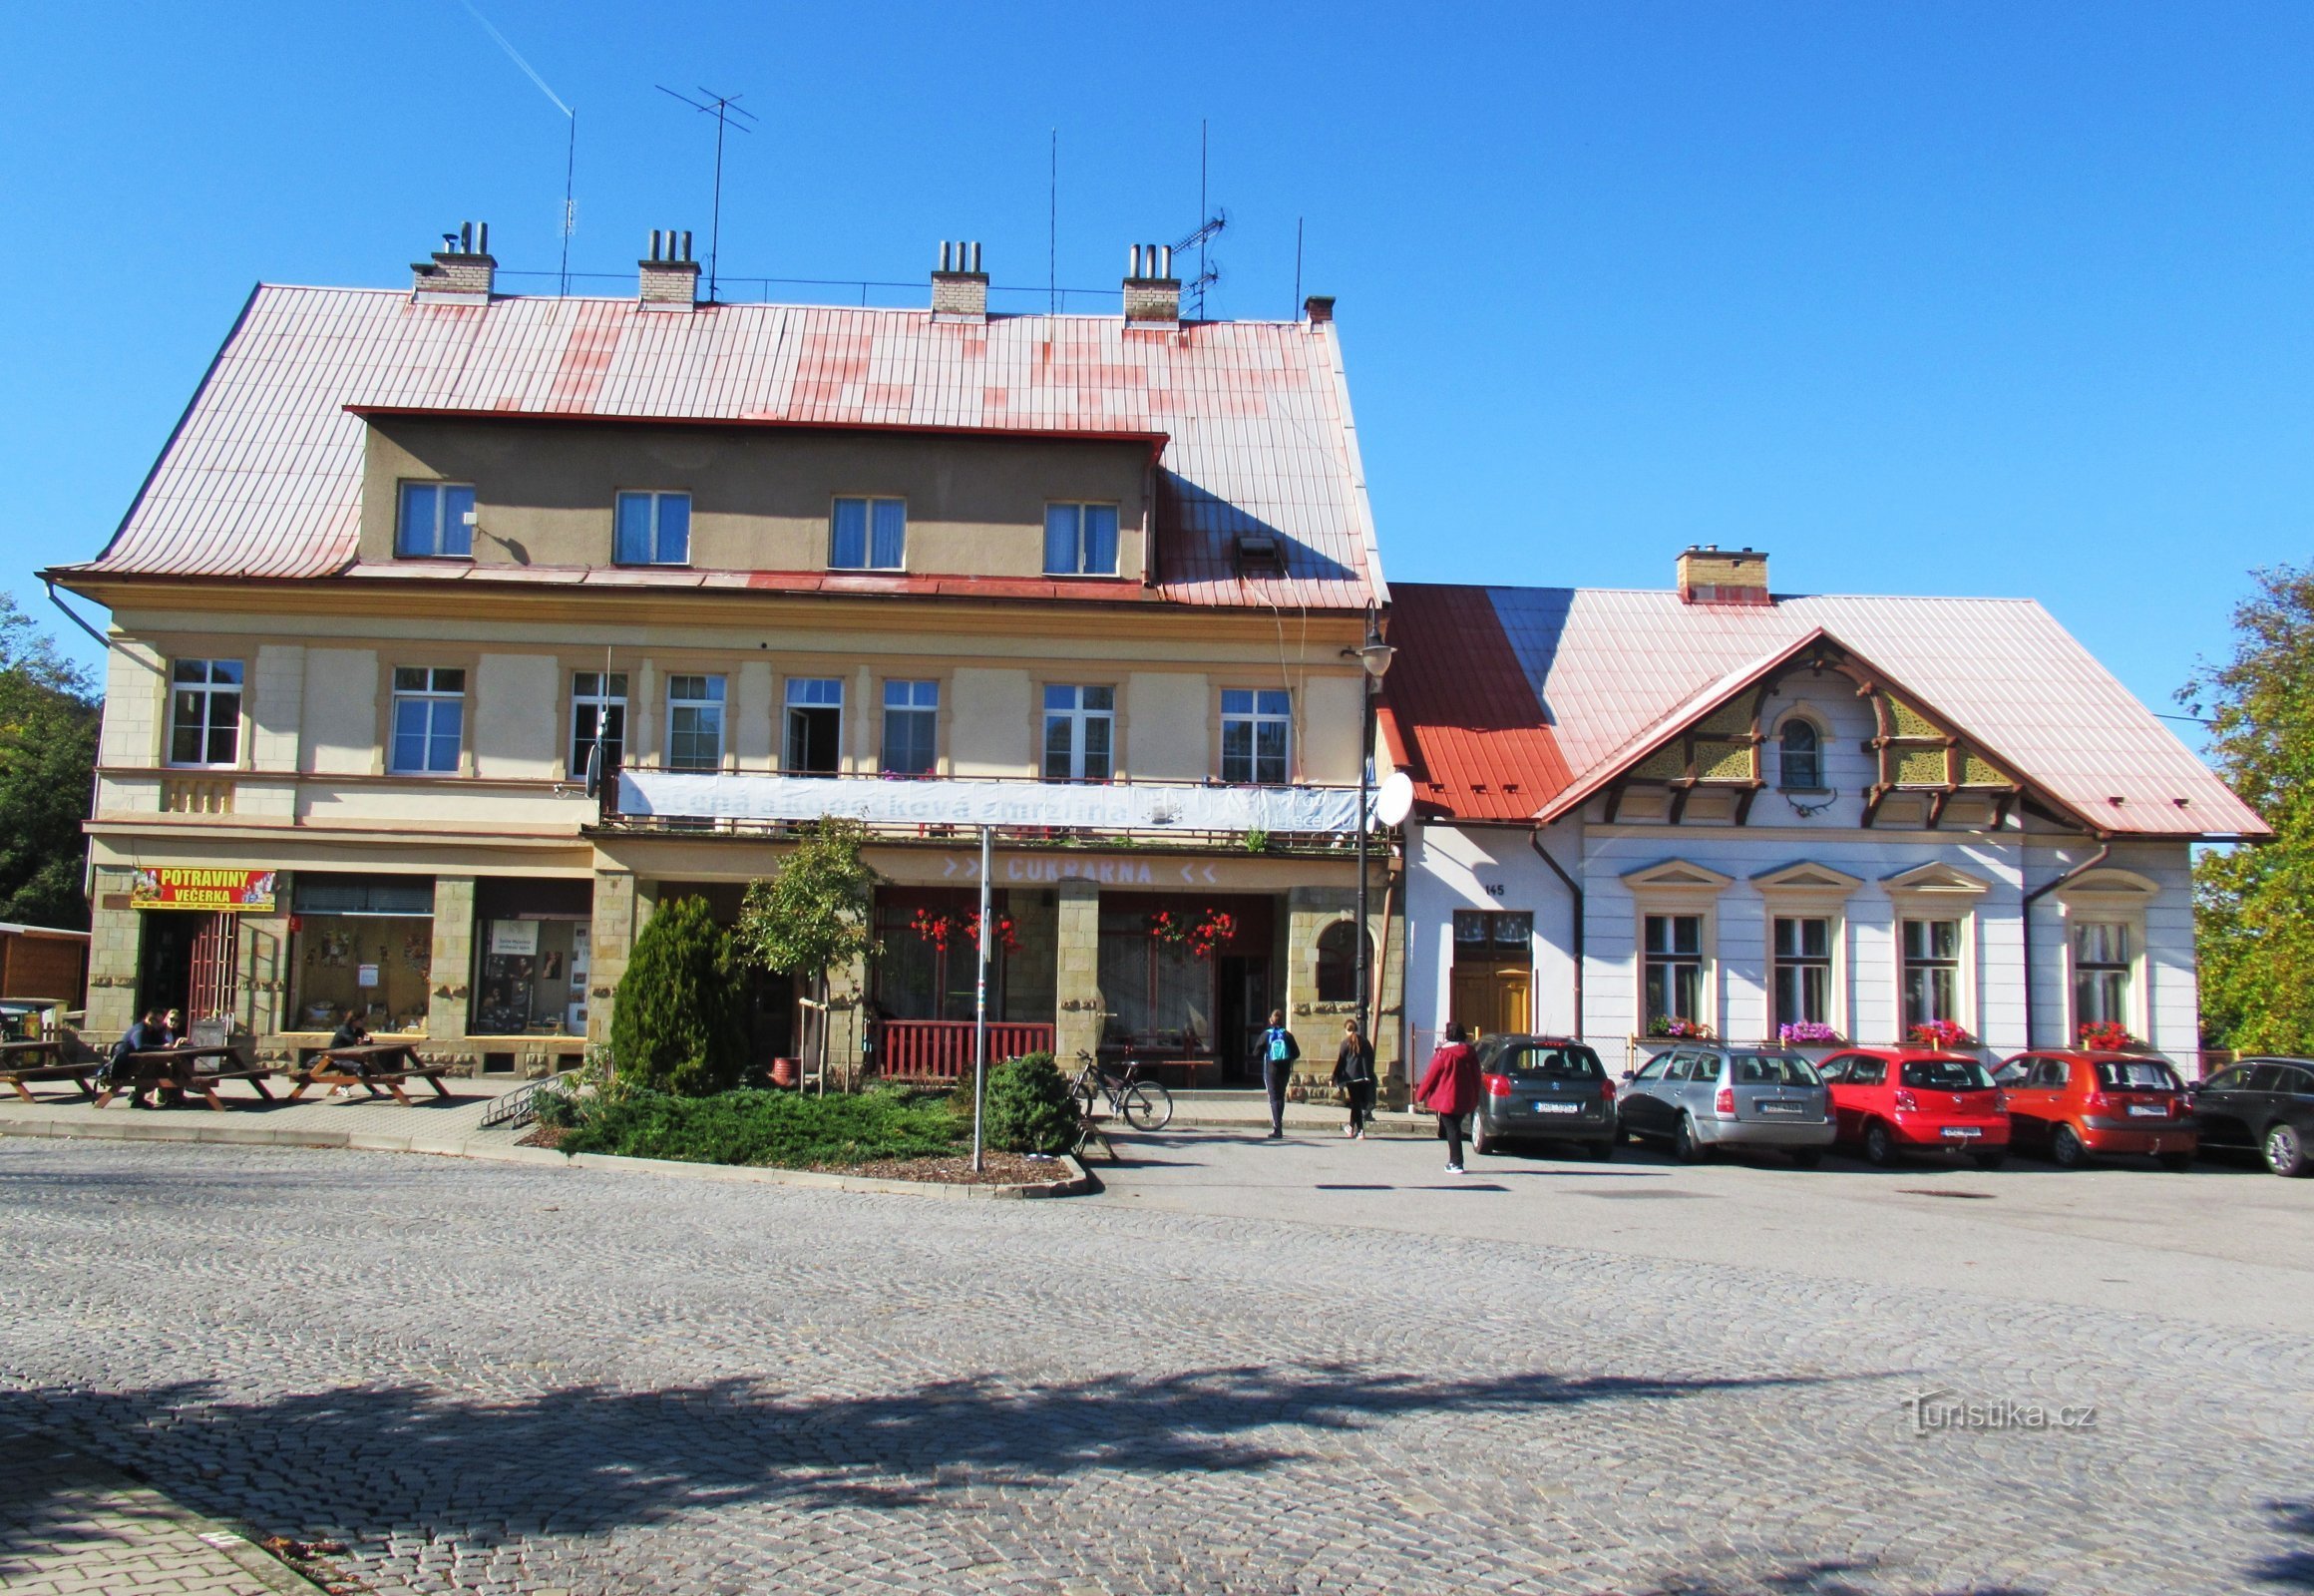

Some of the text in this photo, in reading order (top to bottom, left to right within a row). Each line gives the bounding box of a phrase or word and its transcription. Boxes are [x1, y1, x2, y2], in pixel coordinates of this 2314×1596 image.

[161, 869, 249, 888] POTRAVINY
[175, 887, 230, 903] VEČERKA
[1485, 884, 1505, 896] 145
